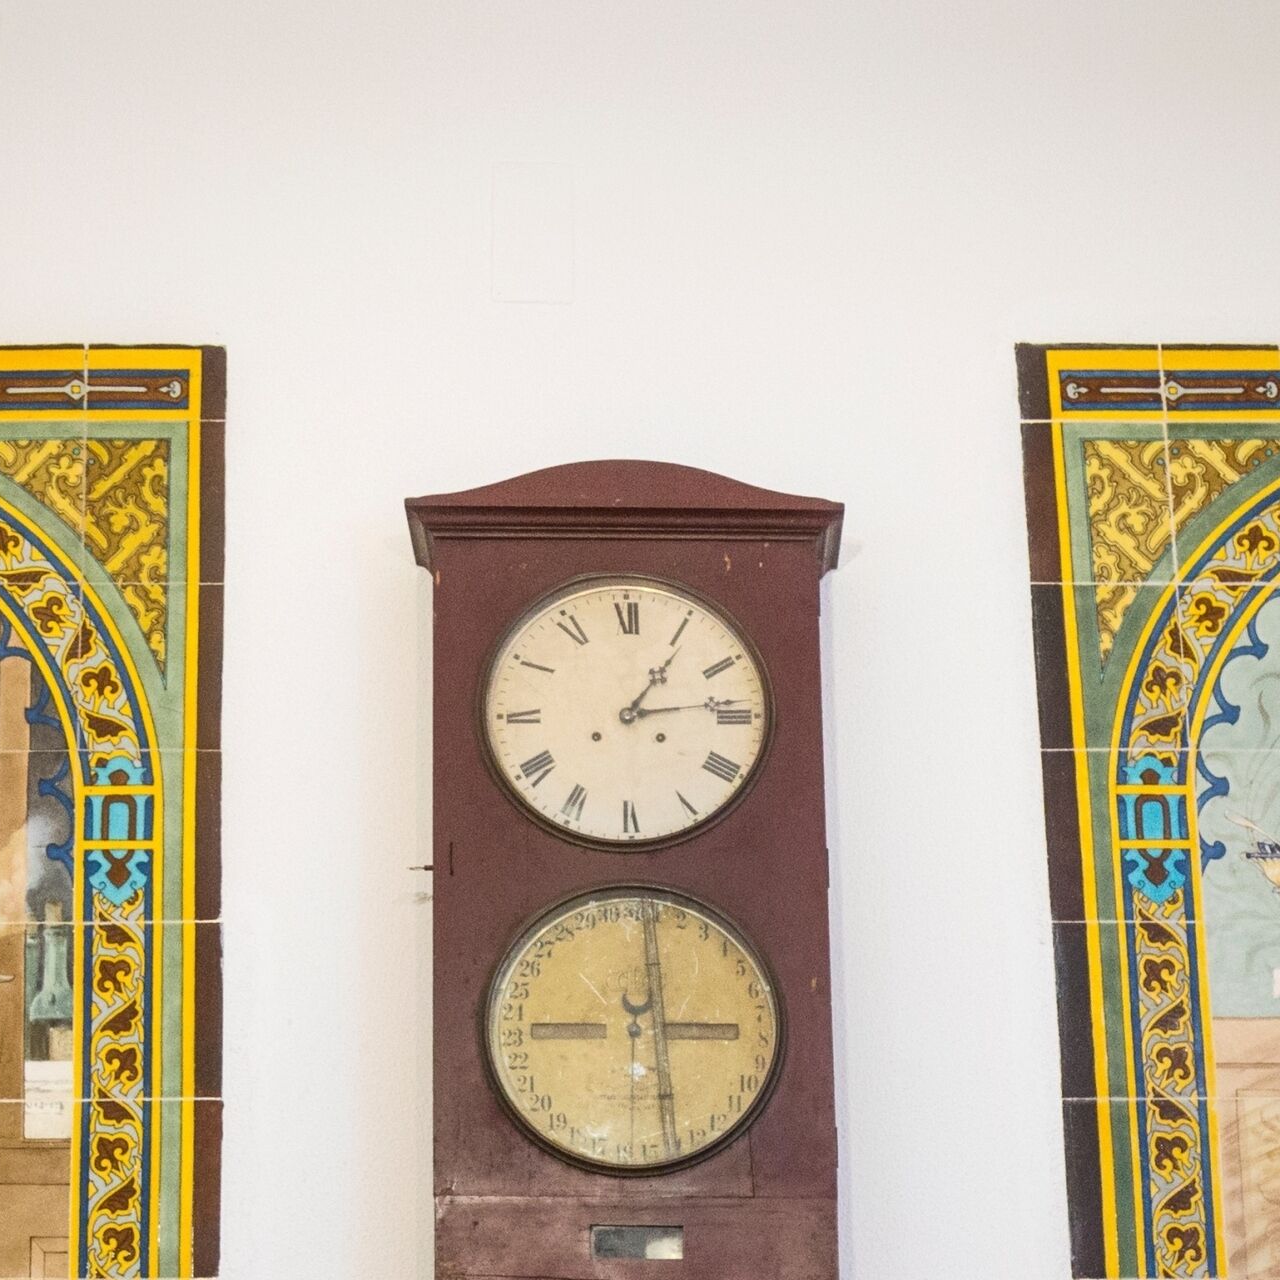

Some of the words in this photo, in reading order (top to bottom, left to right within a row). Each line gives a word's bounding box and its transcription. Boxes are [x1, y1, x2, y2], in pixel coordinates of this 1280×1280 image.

[669, 617, 689, 647] I
[703, 655, 735, 680] II
[716, 709, 752, 725] III
[575, 912, 597, 929] 29
[676, 912, 688, 929] 2
[698, 923, 709, 941] 3
[520, 961, 540, 977] 26
[736, 960, 746, 976] 5
[509, 982, 529, 999] 25
[748, 982, 760, 998] 6
[502, 1004, 523, 1021] 24
[502, 1031, 523, 1047] 23
[508, 1053, 529, 1070] 22
[755, 1055, 765, 1071] 9
[517, 1076, 535, 1093] 21
[739, 1075, 758, 1093] 10
[530, 1095, 552, 1112] 20
[727, 1095, 742, 1113] 11
[548, 1113, 567, 1130] 19
